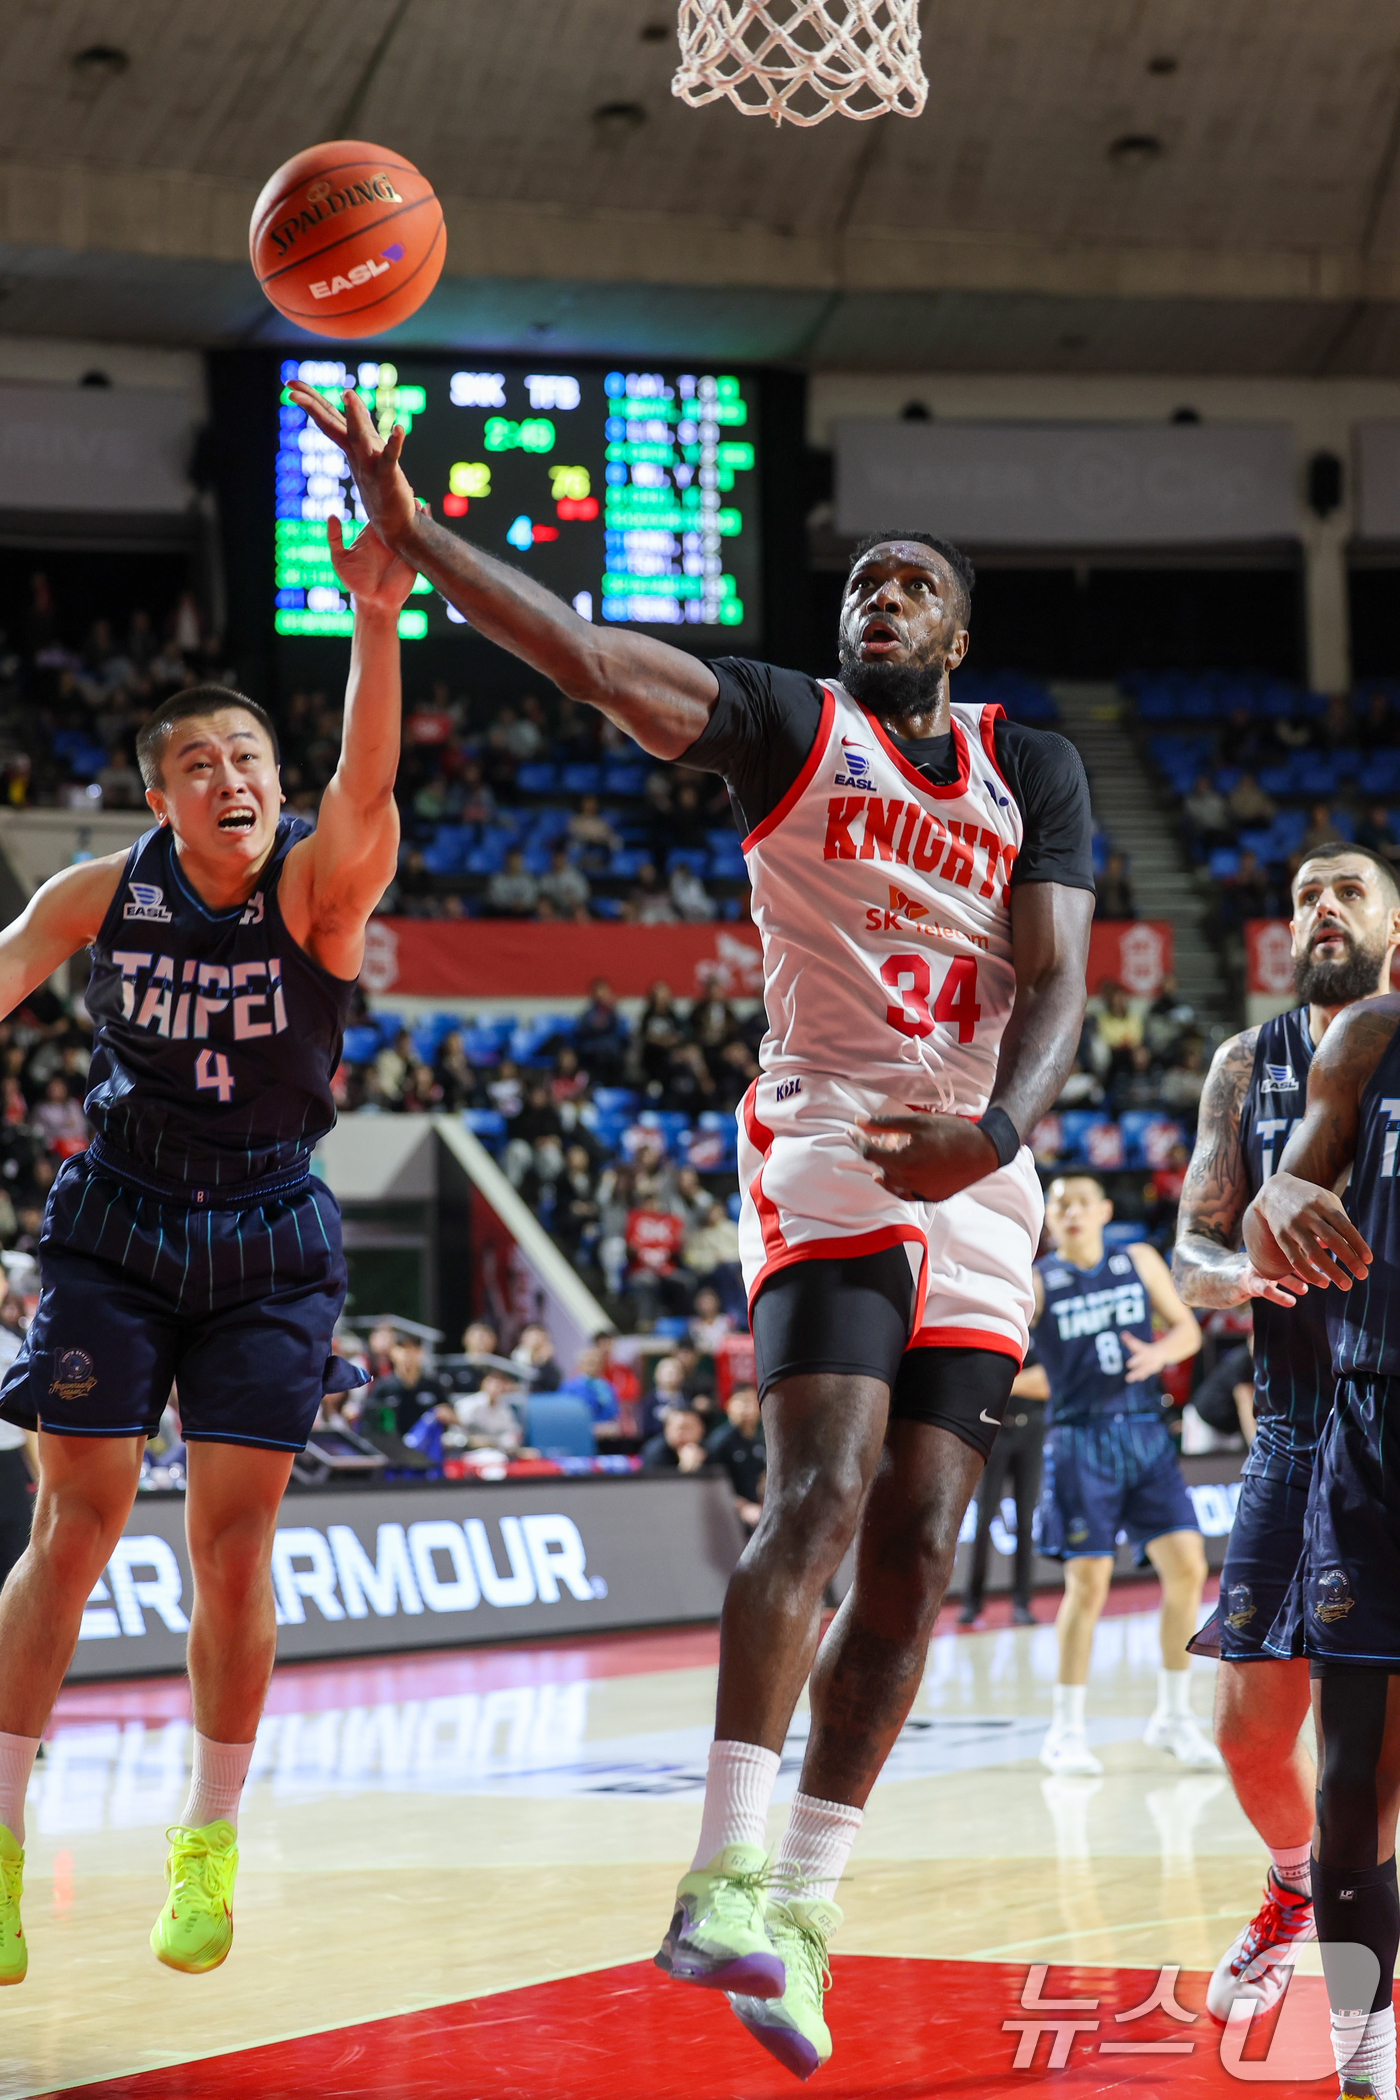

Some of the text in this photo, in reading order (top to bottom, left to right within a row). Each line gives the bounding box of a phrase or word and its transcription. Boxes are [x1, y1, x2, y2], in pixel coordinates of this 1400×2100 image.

[270, 173, 402, 257] SPALDING
[308, 259, 390, 299] EASL
[834, 774, 877, 792] EASL
[126, 906, 169, 919] EASL
[866, 908, 903, 931] SK
[111, 950, 289, 1041] TAIPEI
[880, 954, 981, 1043] 34
[194, 1048, 235, 1102] 4
[271, 1513, 596, 1625] RMOUR
